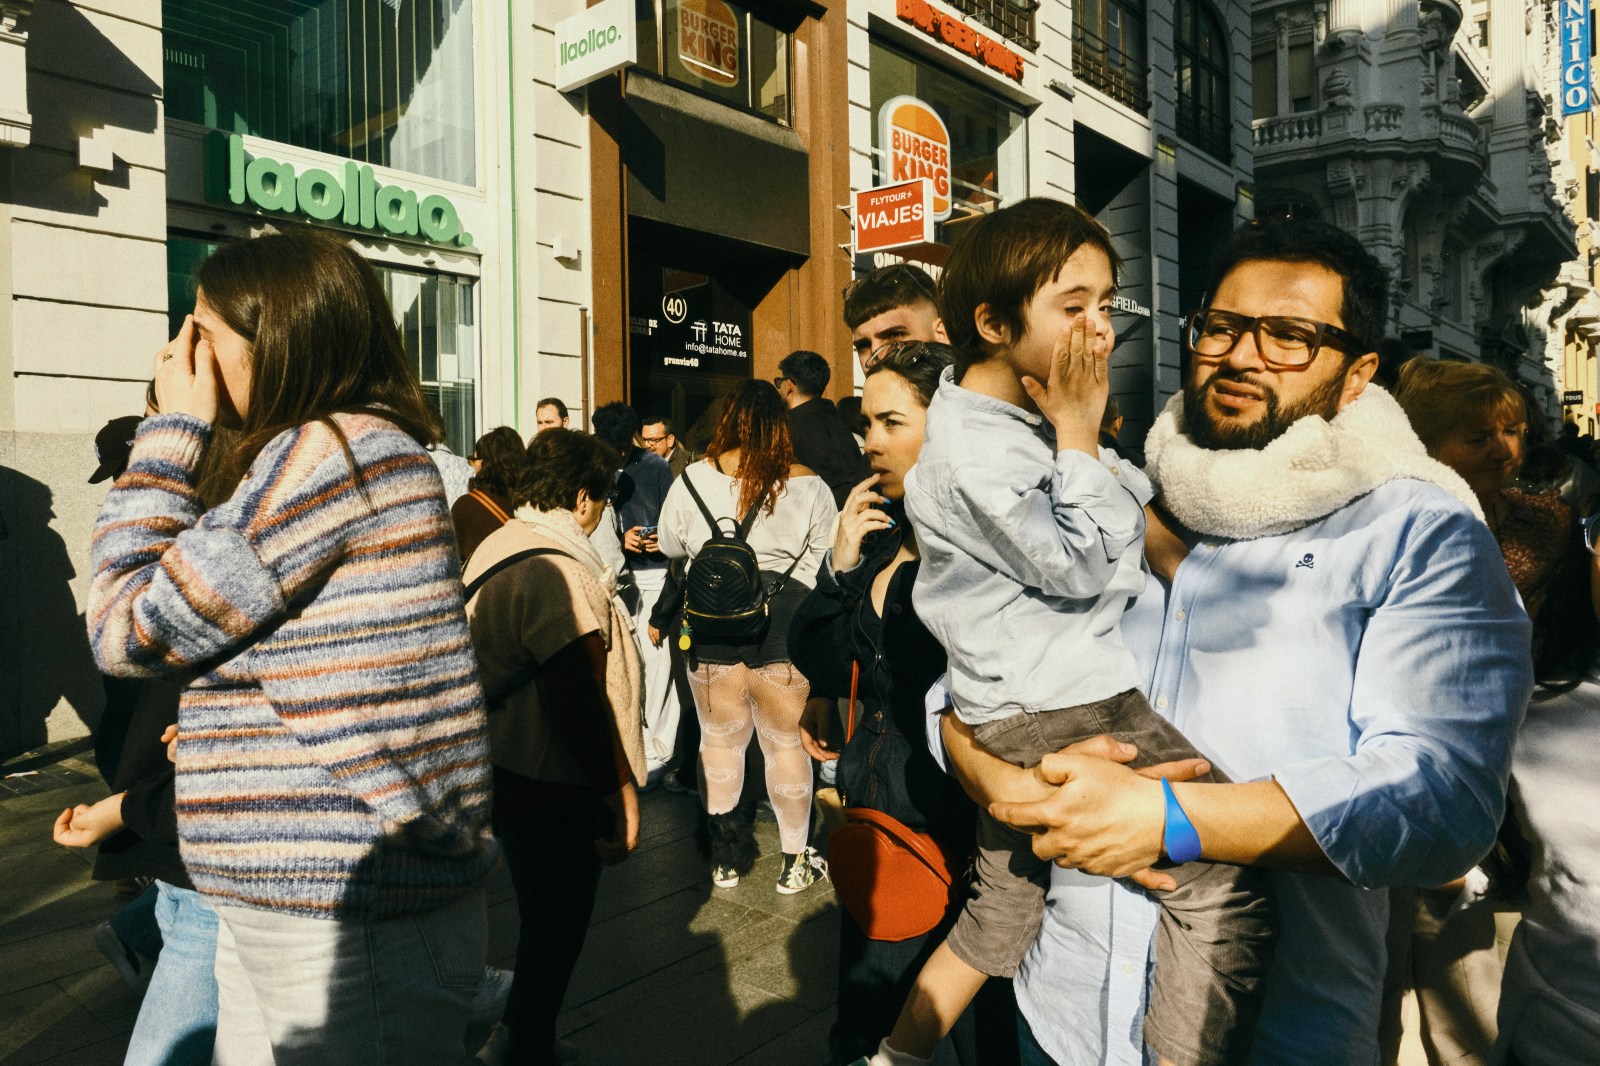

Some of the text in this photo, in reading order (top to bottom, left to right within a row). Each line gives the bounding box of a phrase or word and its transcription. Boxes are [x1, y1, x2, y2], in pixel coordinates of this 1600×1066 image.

[560, 25, 622, 66] llaollao.
[681, 8, 736, 48] BURGER
[681, 27, 737, 71] KING
[1565, 0, 1587, 107] NTICO
[892, 128, 949, 169] BURGER
[892, 151, 949, 197] KING
[858, 203, 923, 230] VIAJES
[666, 298, 683, 317] 40
[713, 321, 742, 336] TATA
[715, 334, 742, 348] HOME
[685, 341, 747, 358] info@tatahome.es
